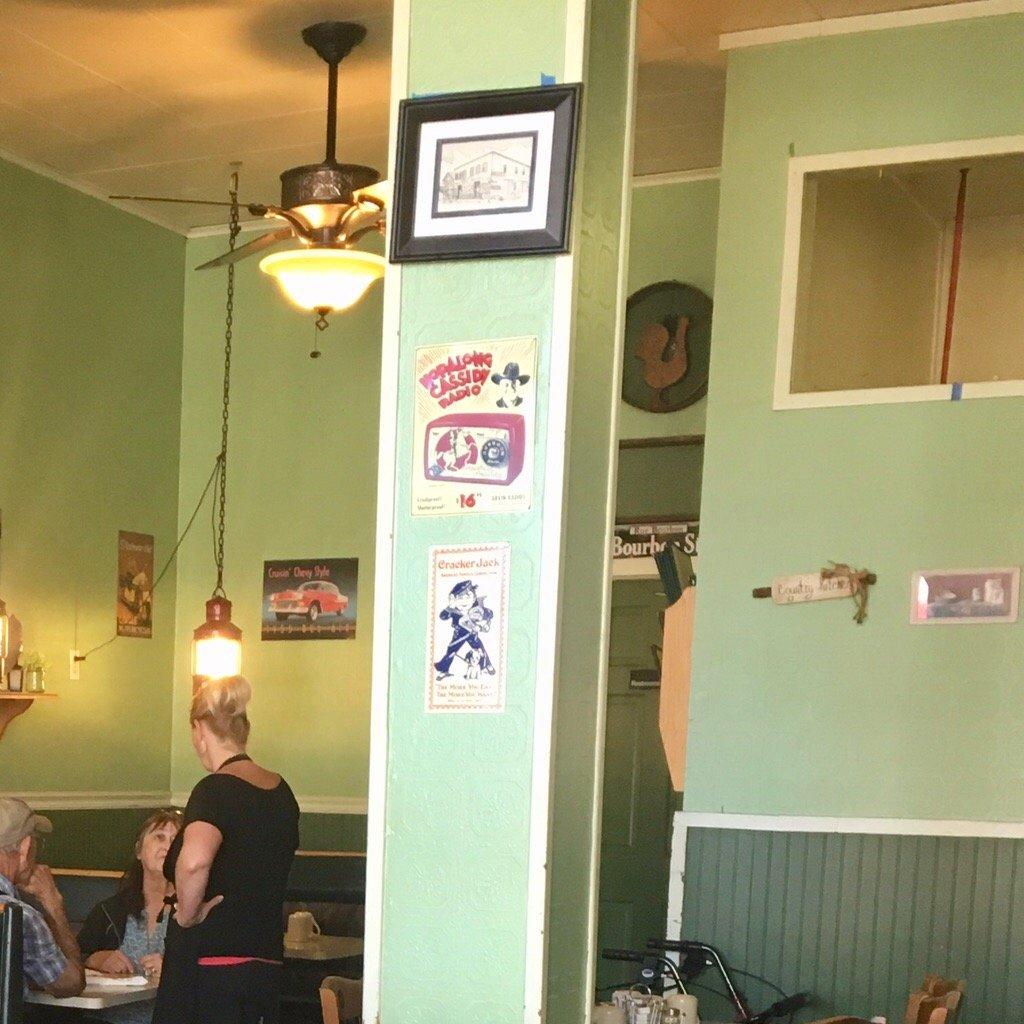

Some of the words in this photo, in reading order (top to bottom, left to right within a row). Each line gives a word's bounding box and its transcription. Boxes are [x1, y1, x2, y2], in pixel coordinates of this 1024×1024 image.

[430, 369, 491, 398] CASSIDY
[438, 385, 482, 409] RADIO
[613, 534, 680, 557] Bourb
[293, 566, 313, 580] Chevy
[314, 565, 330, 578] Style
[438, 560, 475, 570] Cracker
[476, 558, 500, 568] Jack
